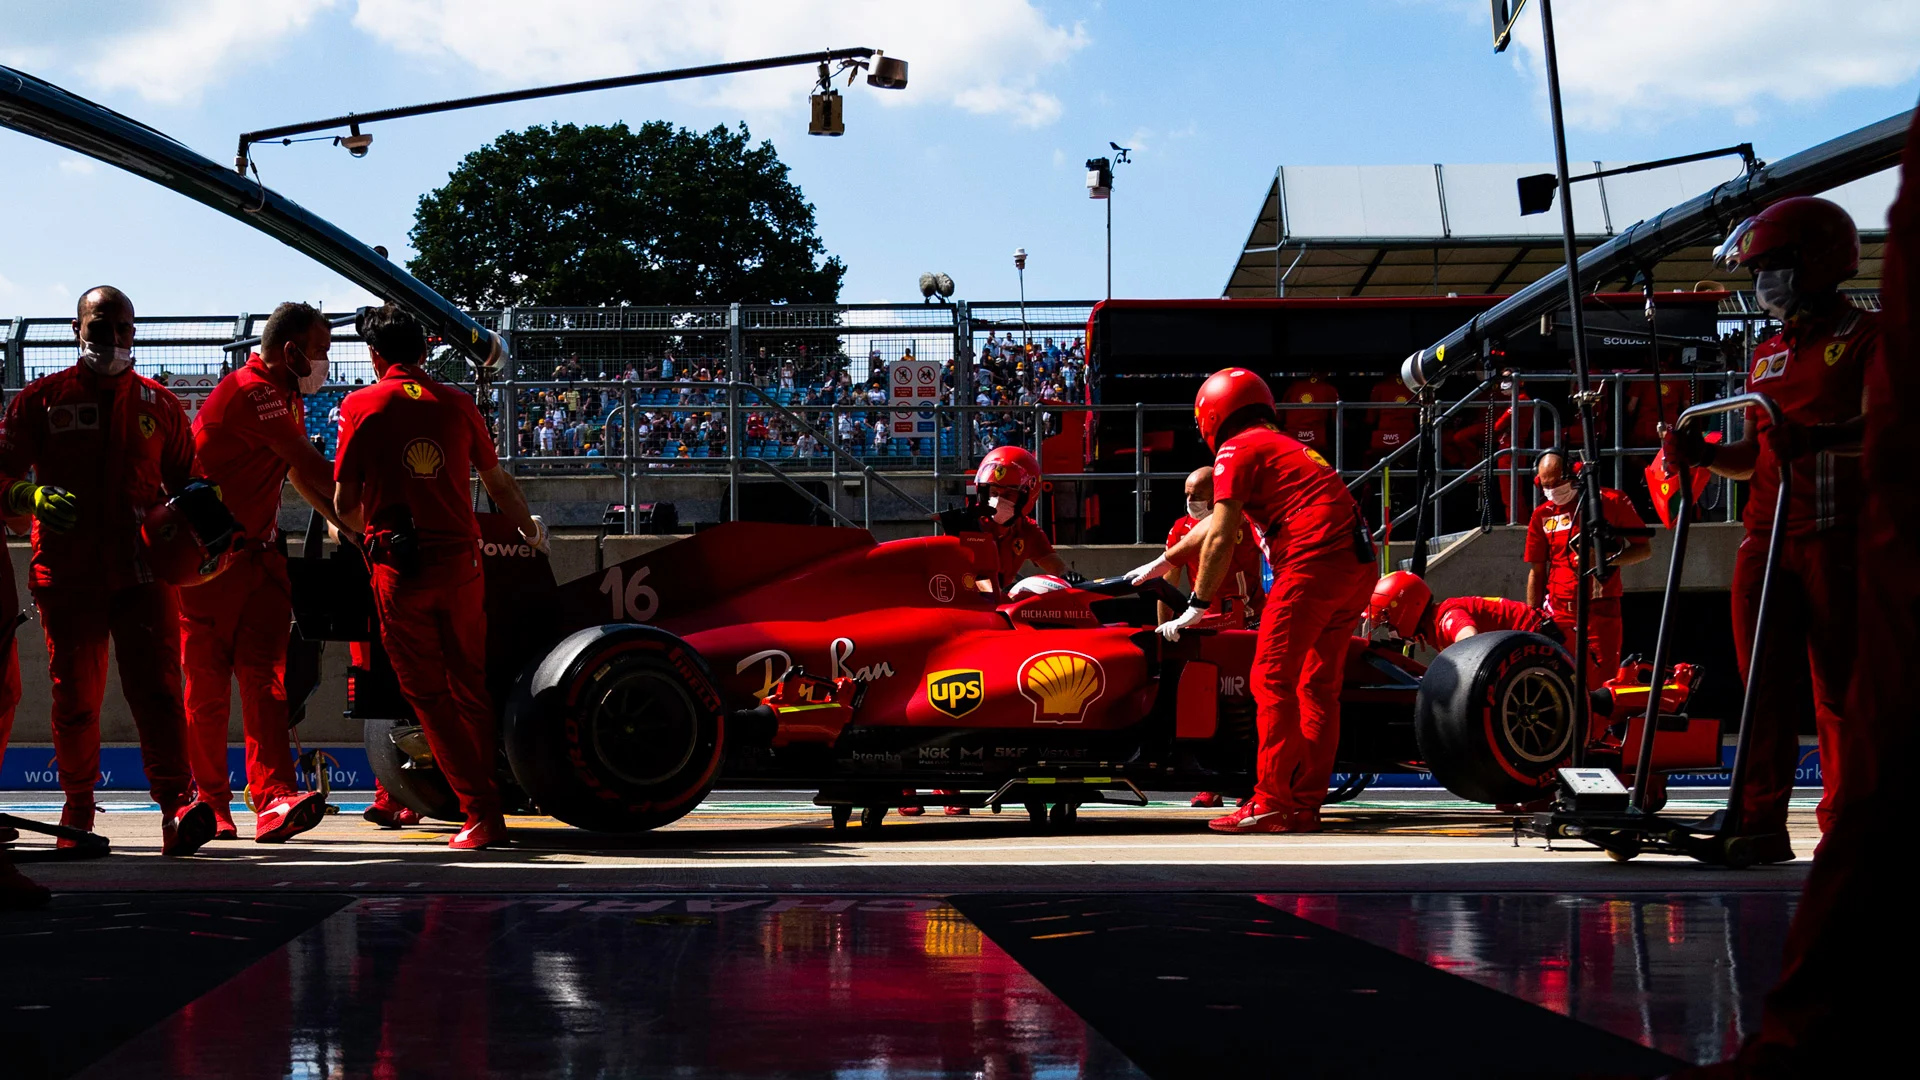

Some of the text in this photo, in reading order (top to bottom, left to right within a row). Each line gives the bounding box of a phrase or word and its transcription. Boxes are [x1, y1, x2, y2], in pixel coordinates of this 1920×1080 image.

[257, 400, 282, 411] MAHLE
[1298, 430, 1315, 438] aws
[1382, 433, 1399, 441] aws
[599, 566, 659, 621] 16
[1021, 610, 1091, 619] RICHARD MILLE
[1496, 644, 1556, 680] ZERO
[736, 637, 895, 704] Ry Ban
[931, 680, 980, 709] ups
[852, 749, 902, 761] brembo
[918, 747, 951, 759] NGK
[993, 747, 1029, 758] SKF
